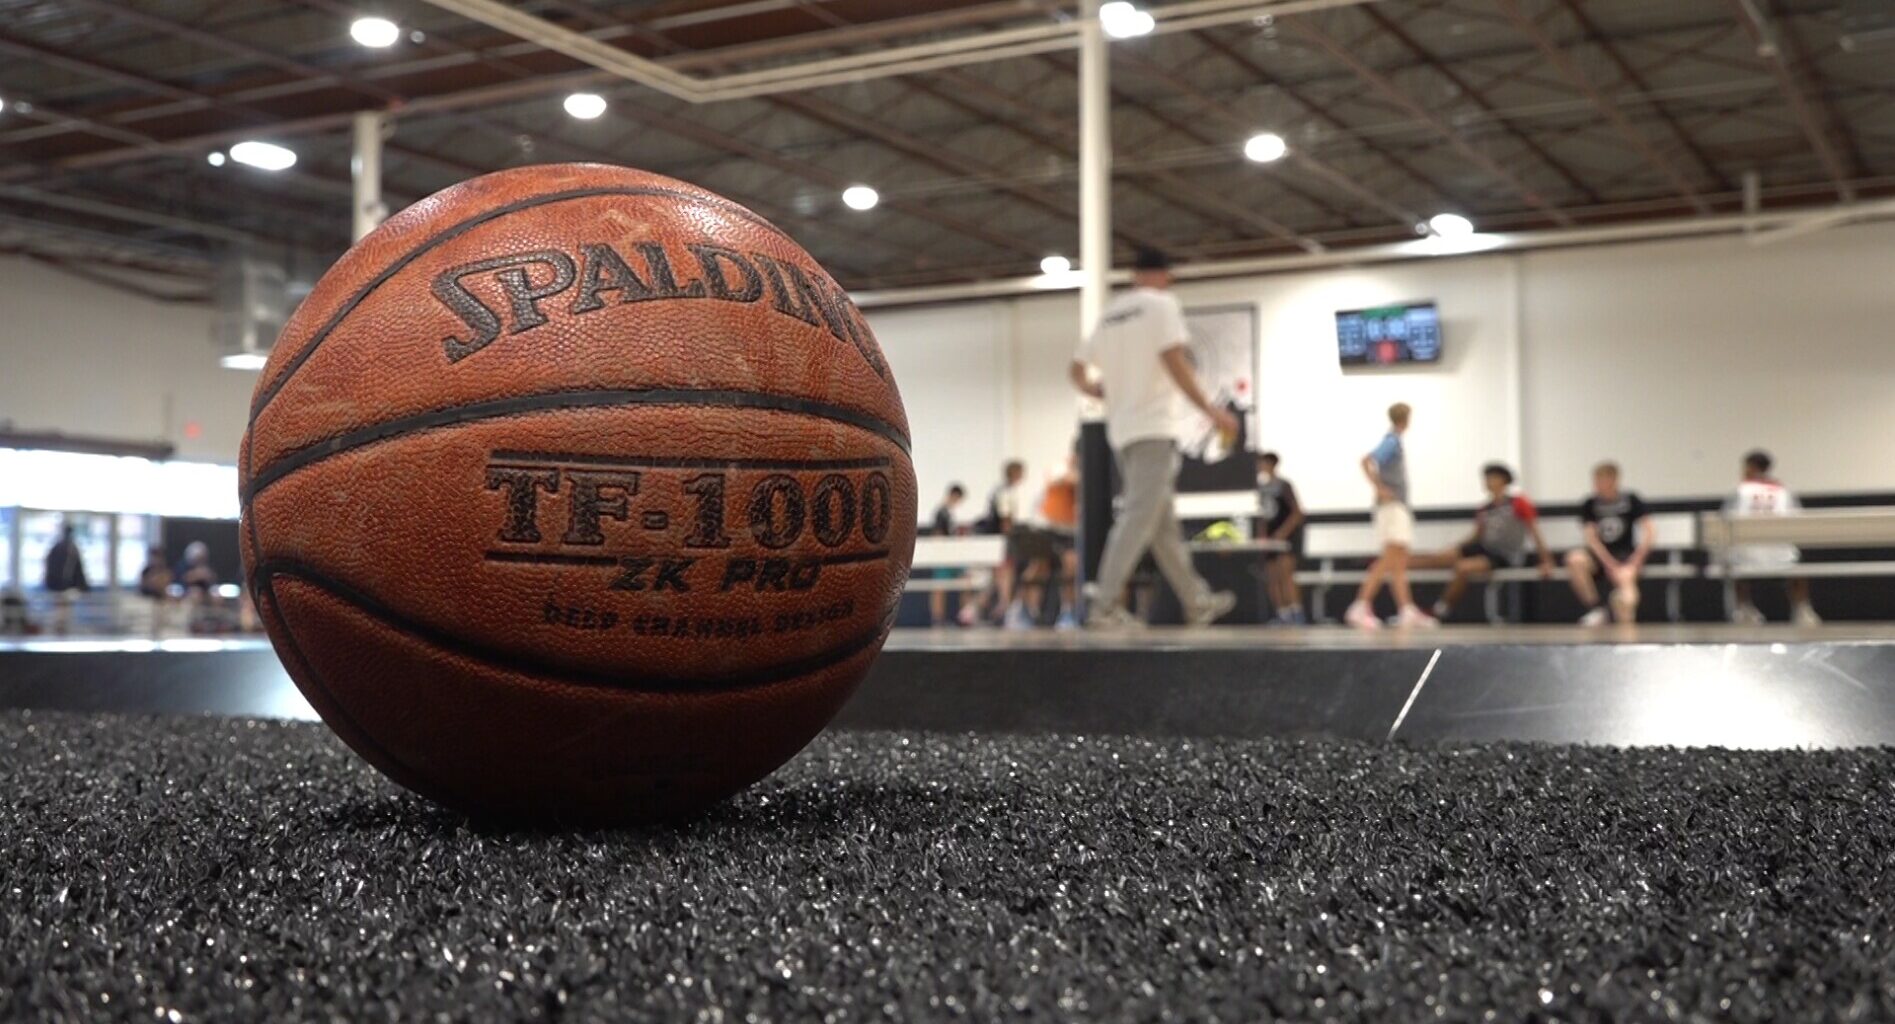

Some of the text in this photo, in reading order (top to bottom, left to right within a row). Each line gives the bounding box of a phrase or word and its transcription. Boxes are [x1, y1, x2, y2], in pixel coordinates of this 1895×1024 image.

[484, 465, 891, 549] TF-1000
[609, 556, 823, 592] ZK PRO
